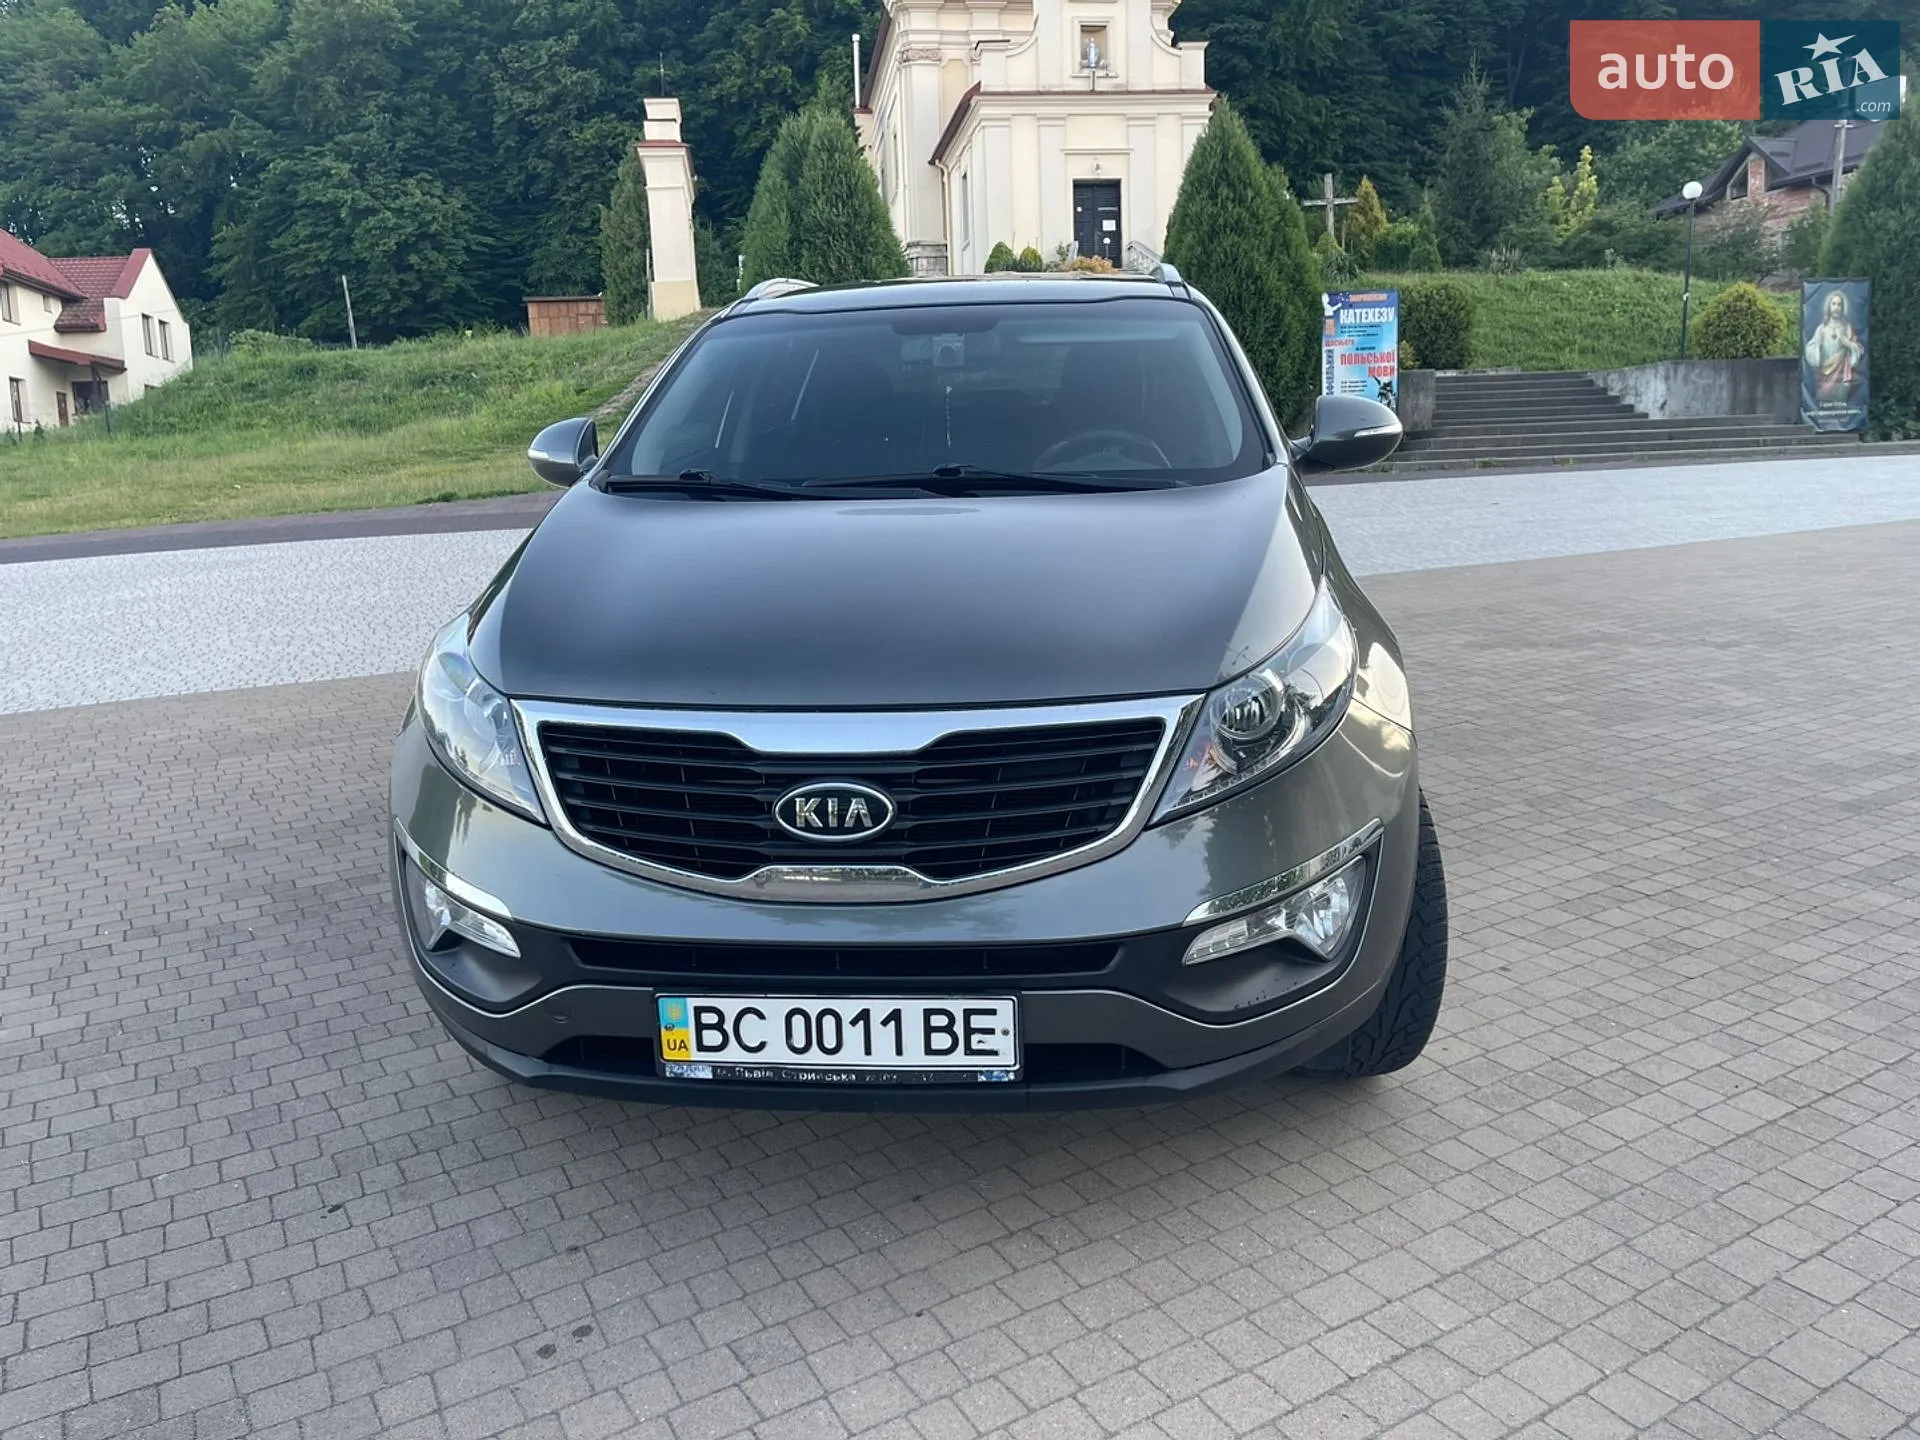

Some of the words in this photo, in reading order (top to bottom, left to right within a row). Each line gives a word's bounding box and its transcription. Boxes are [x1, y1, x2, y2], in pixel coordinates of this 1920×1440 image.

[1368, 364, 1395, 377] МОВИ
[795, 798, 873, 828] KIA
[694, 1005, 768, 1054] BC
[785, 1007, 903, 1056] 0011
[666, 1039, 689, 1052] UA
